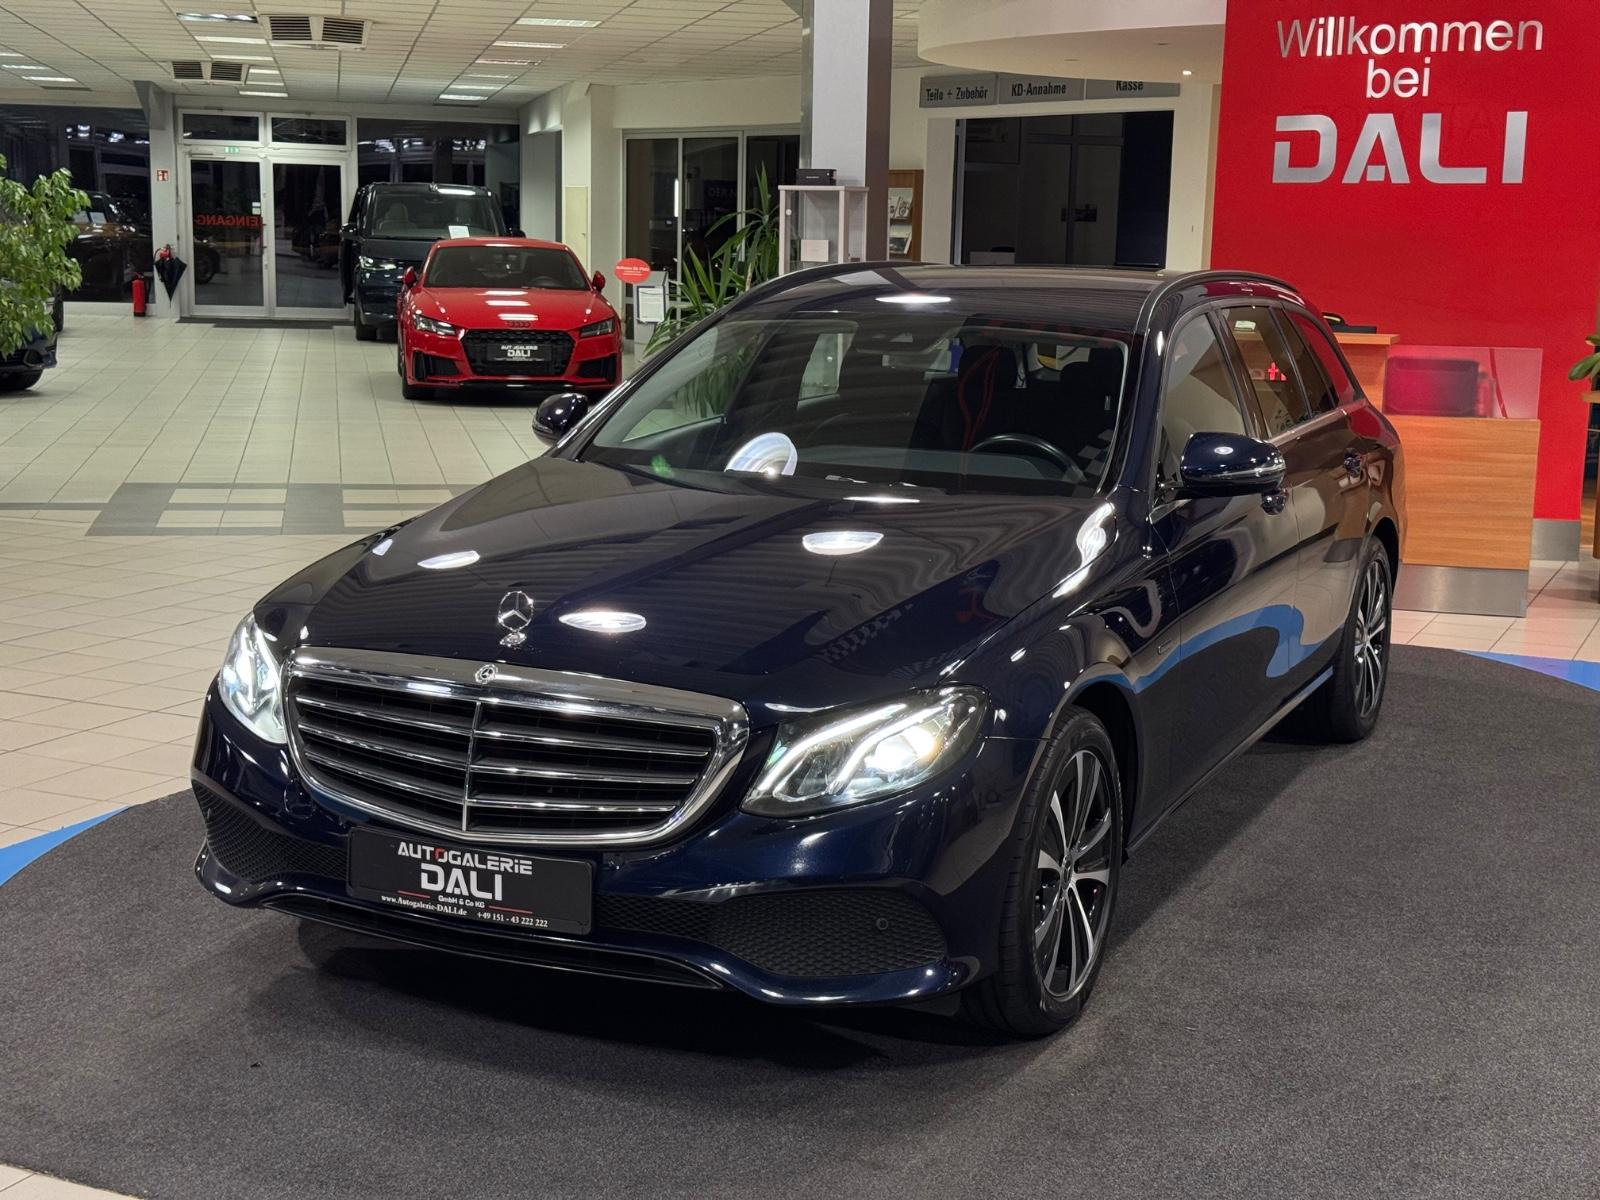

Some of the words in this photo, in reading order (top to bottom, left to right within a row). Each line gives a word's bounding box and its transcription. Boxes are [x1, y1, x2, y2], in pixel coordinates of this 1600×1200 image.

[1277, 16, 1543, 58] Willkommen
[1011, 82, 1066, 97] KD-Annahme
[1366, 56, 1431, 98] bei
[956, 86, 988, 100] Zubehör
[1271, 110, 1528, 184] DALI
[397, 841, 533, 875] AUTOGALERIE
[420, 863, 502, 901] DALI
[381, 895, 467, 916] www.Autogalerie-DALI.de
[438, 895, 458, 904] GmbH
[458, 898, 464, 906] &
[465, 899, 474, 907] Co
[475, 900, 485, 909] KG
[477, 911, 491, 920] +49
[492, 913, 504, 921] 151
[510, 915, 519, 924] 43
[521, 917, 533, 926] 222
[535, 918, 548, 928] 222
